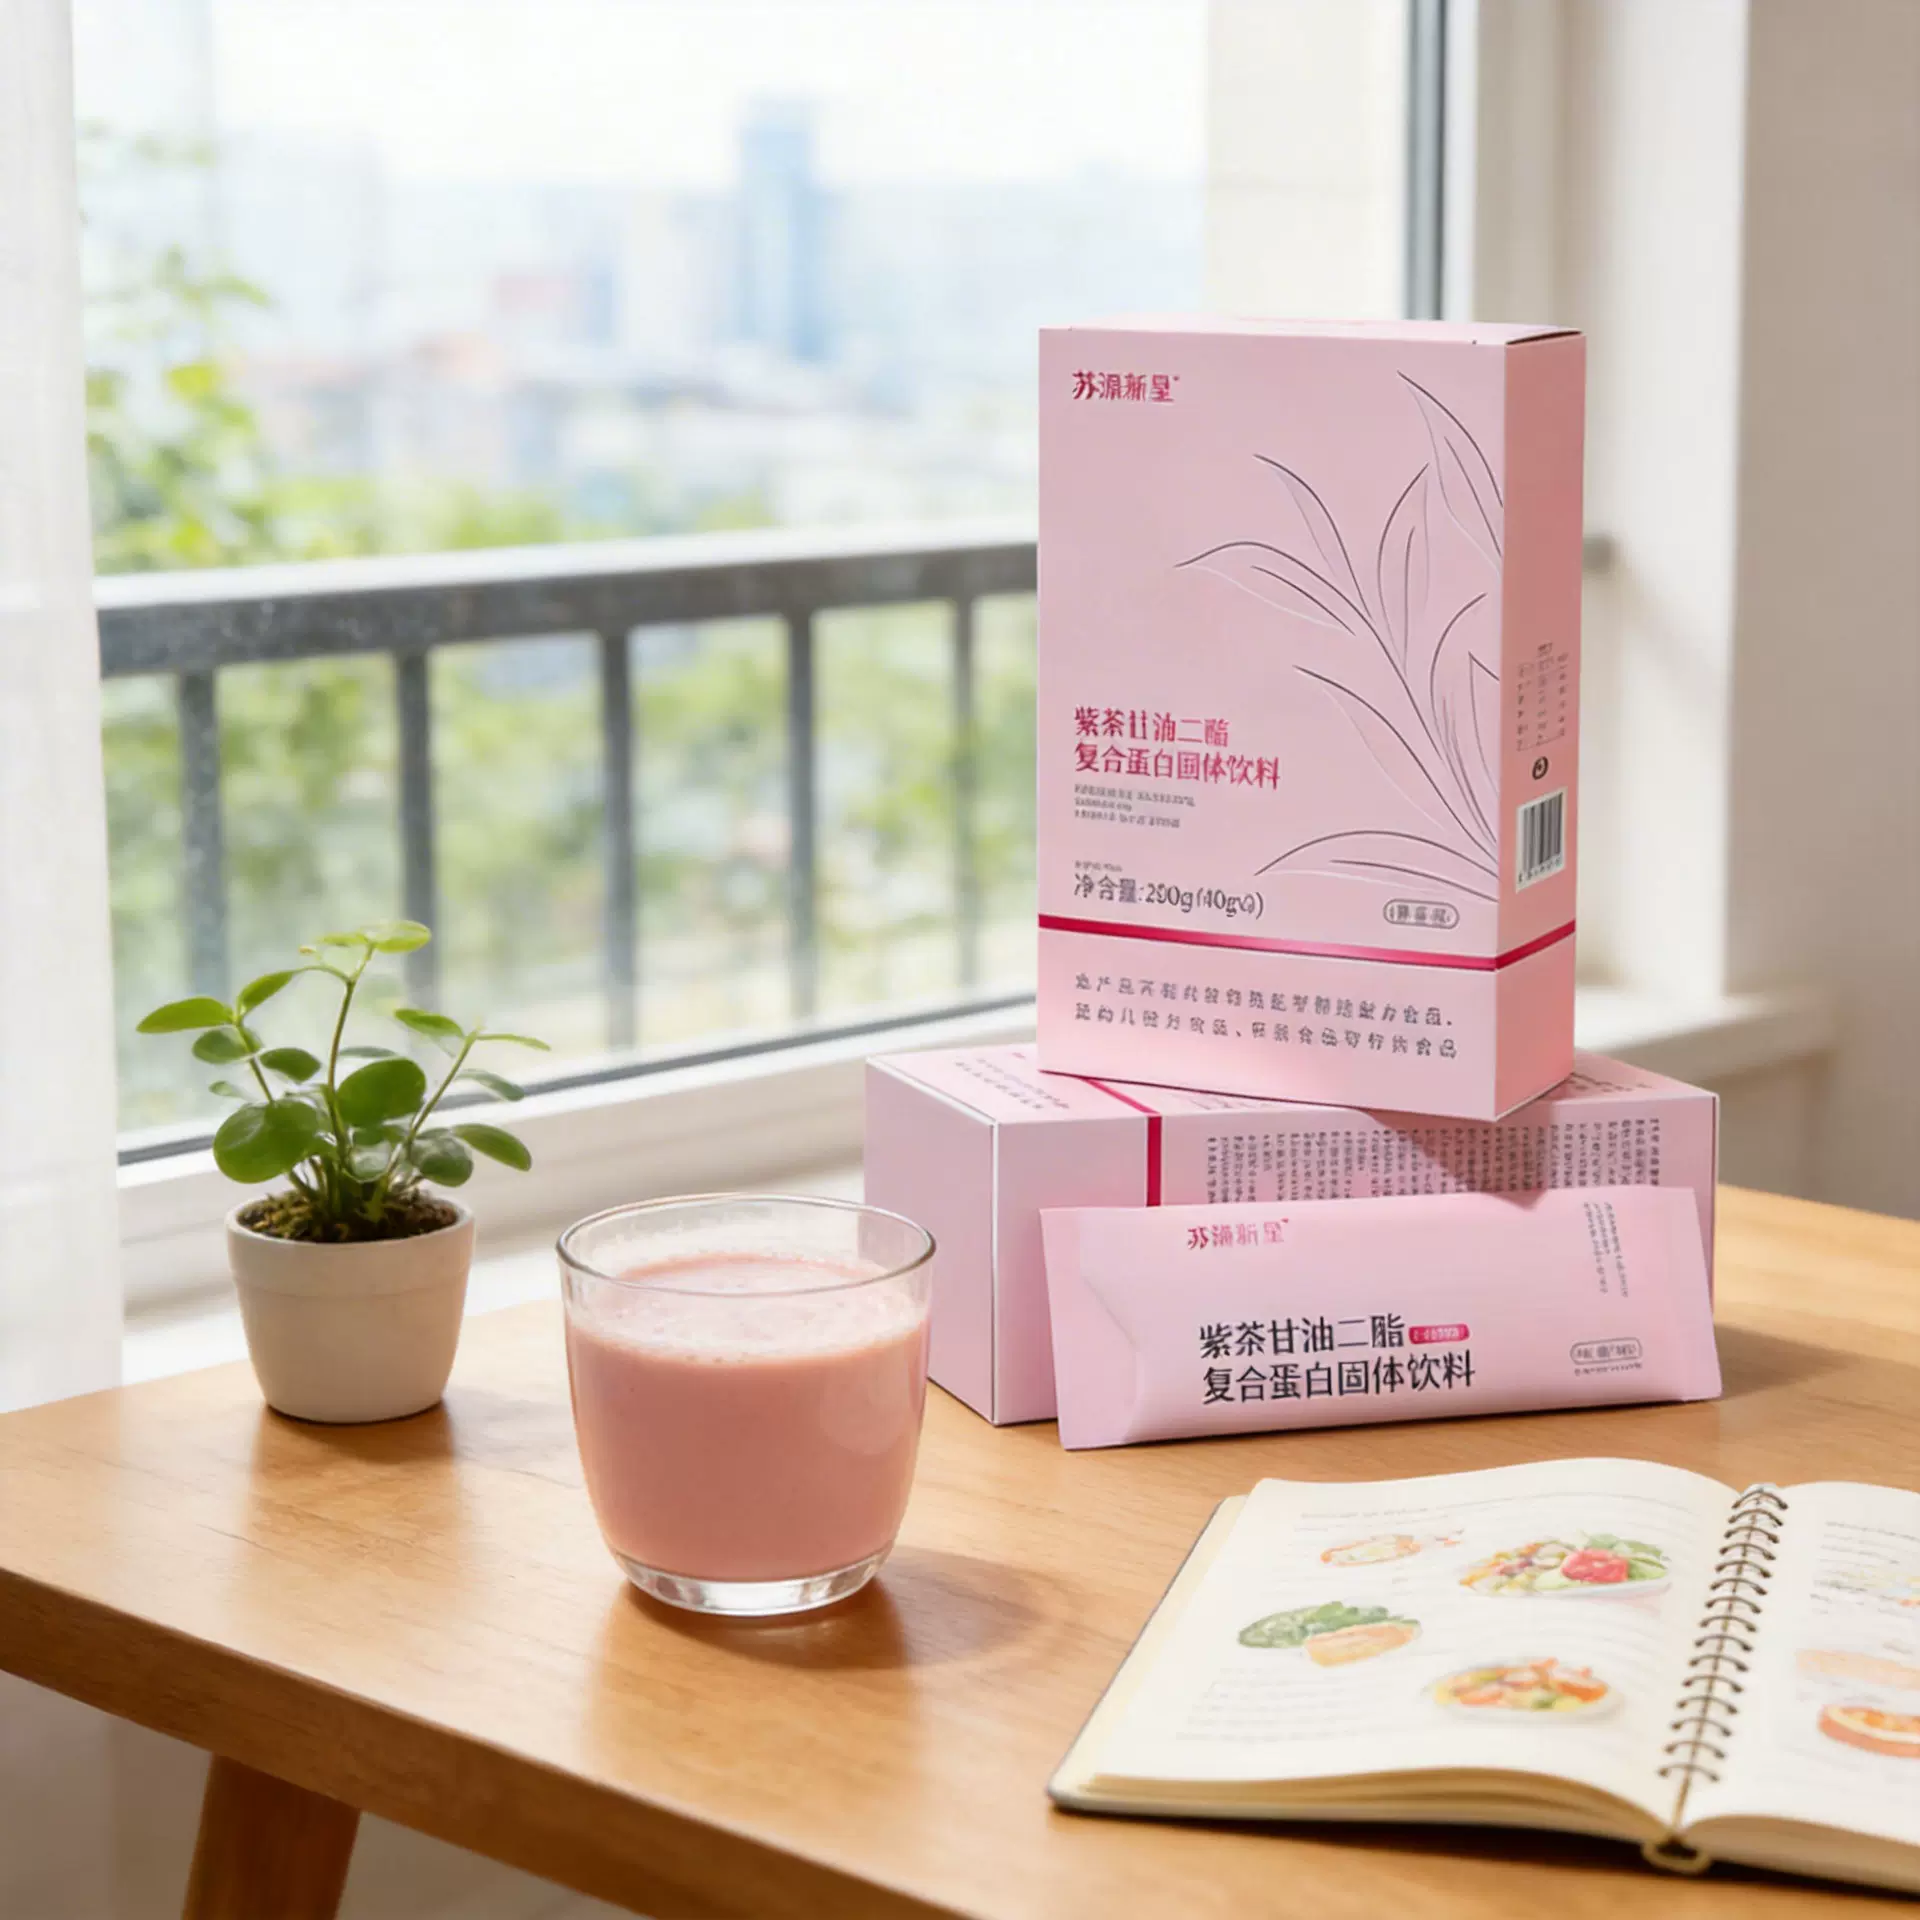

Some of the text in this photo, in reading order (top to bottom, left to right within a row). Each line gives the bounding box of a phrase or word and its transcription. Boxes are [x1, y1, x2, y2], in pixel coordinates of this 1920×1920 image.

[1203, 1349, 1476, 1405] 复合蛋白固体饮料
